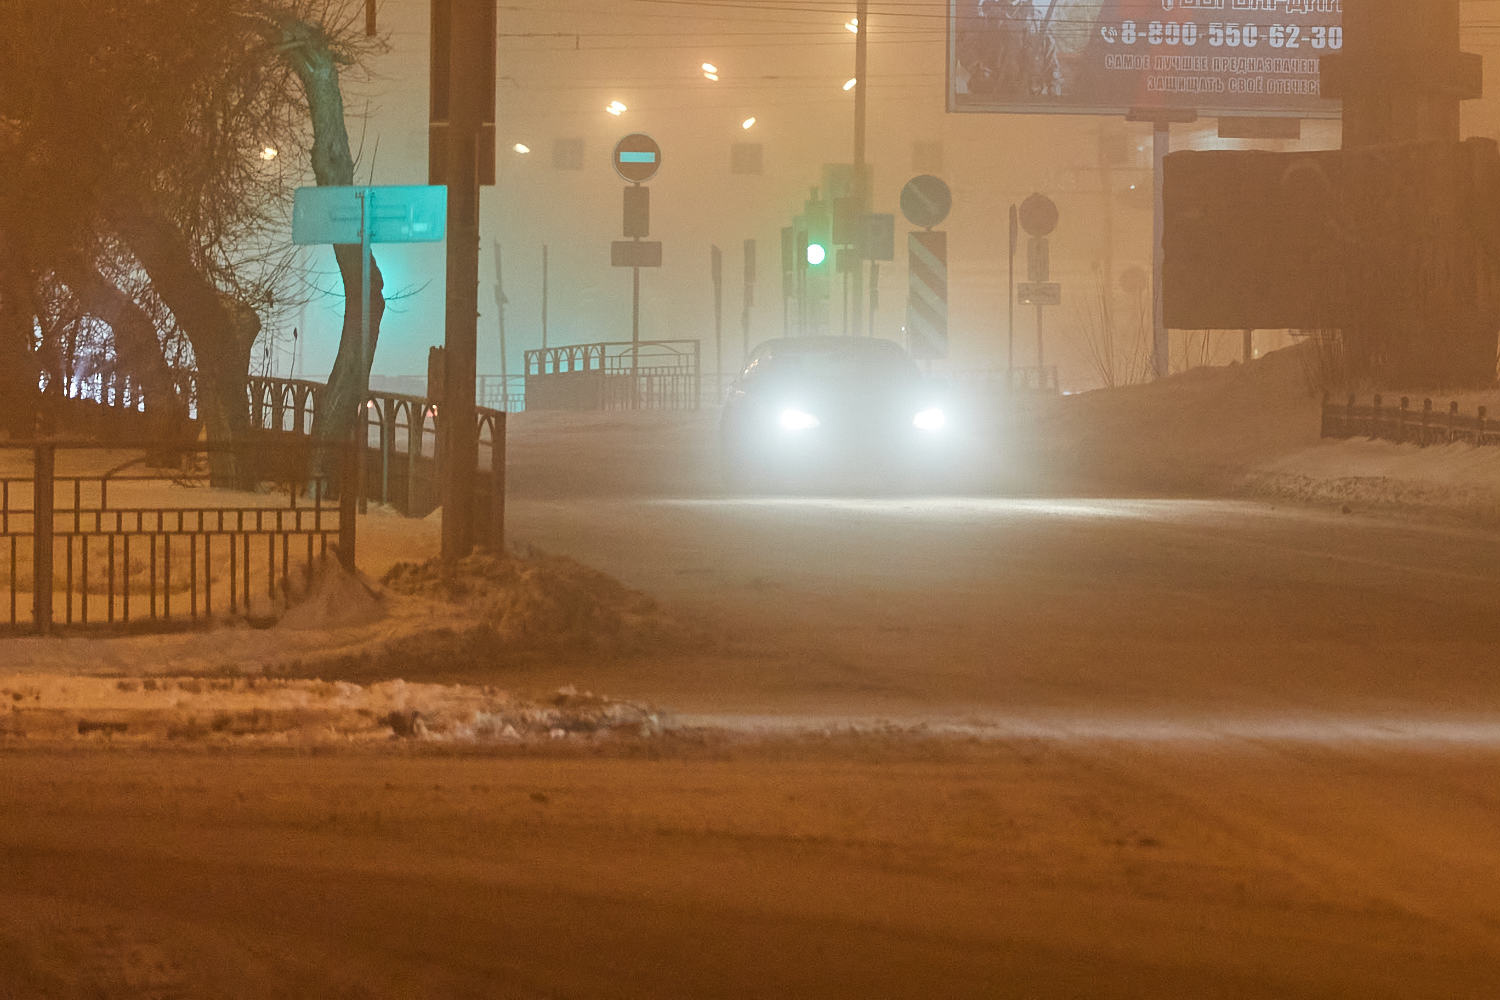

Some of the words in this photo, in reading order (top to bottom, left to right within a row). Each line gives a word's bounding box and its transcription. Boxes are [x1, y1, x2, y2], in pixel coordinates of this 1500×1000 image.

[1104, 54, 1151, 71] САМОЕ
[1154, 55, 1208, 72] ЛУЧШЕЕ
[1147, 75, 1224, 94] ЗАЩИЩАТЬ
[1228, 76, 1263, 94] СВОЁ
